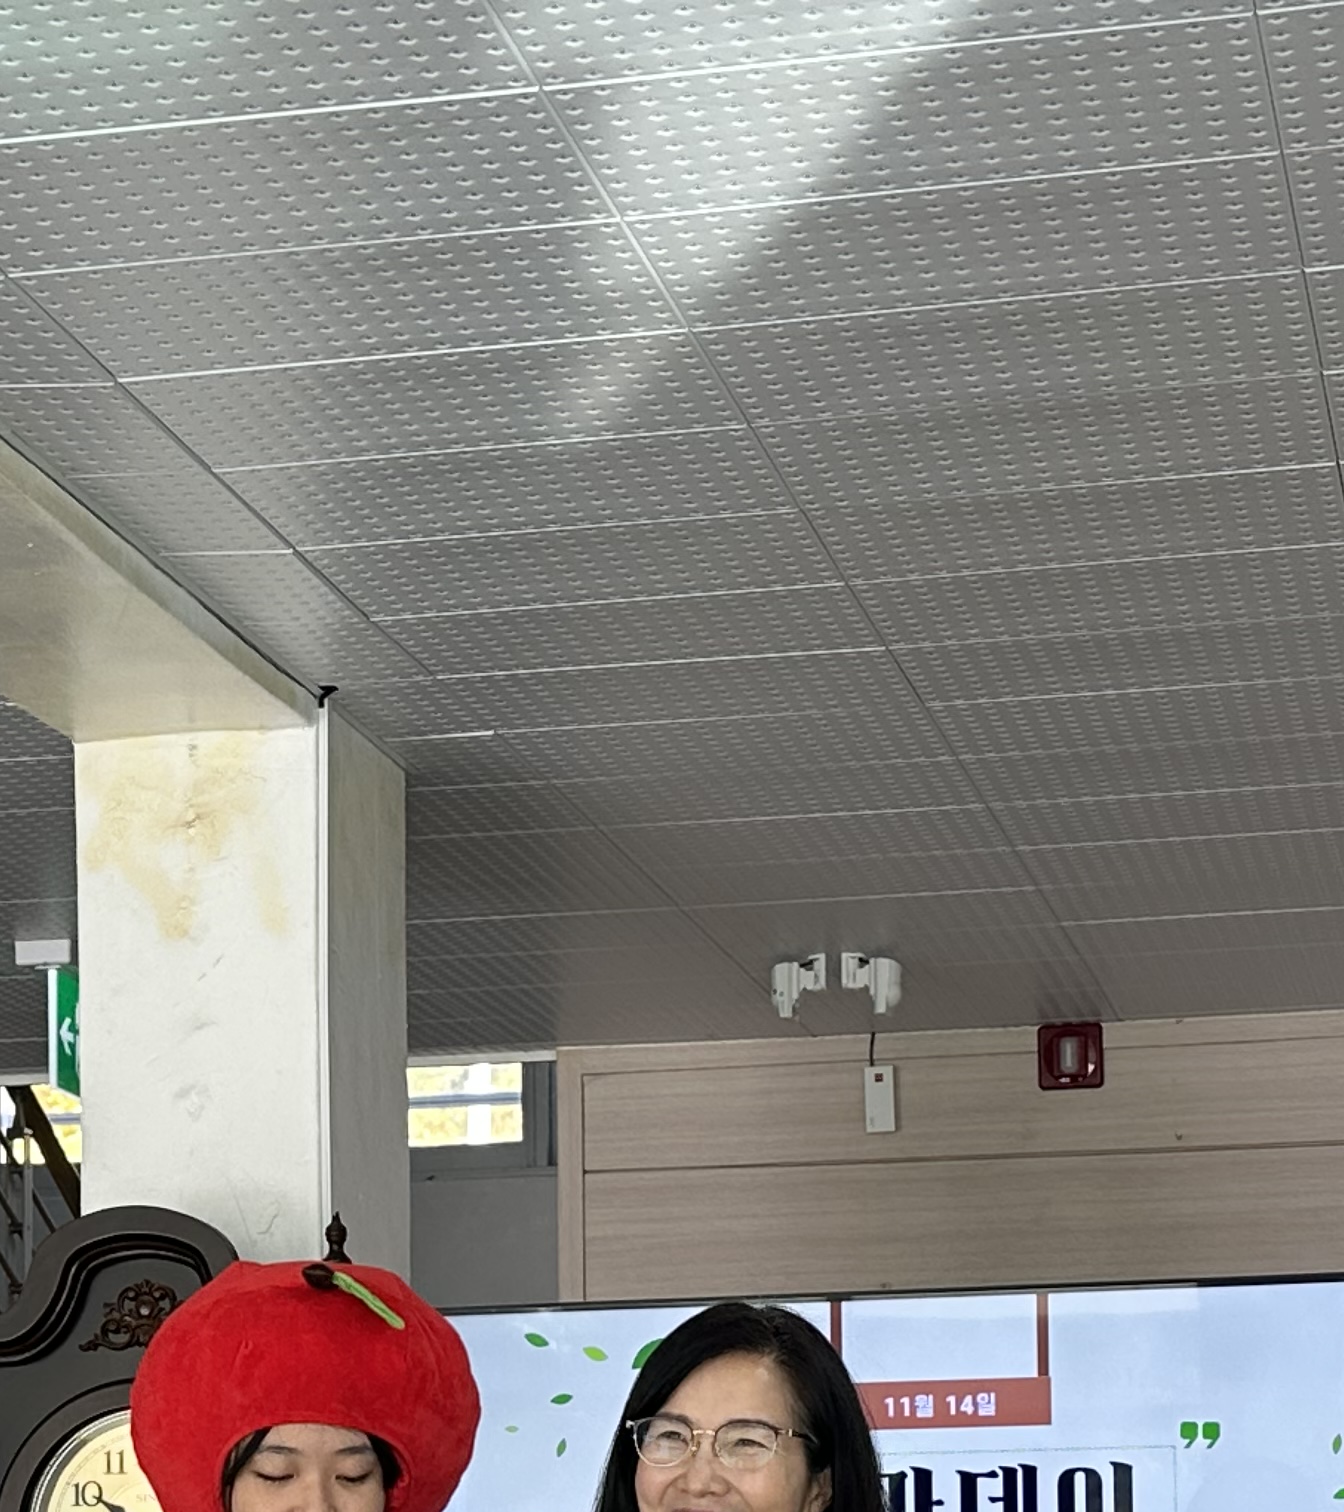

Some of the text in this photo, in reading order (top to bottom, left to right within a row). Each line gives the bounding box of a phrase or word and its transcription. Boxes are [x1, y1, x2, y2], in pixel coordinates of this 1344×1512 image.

[884, 1392, 996, 1418] 11월 14일
[103, 1450, 127, 1475] 11
[71, 1481, 102, 1507] 10
